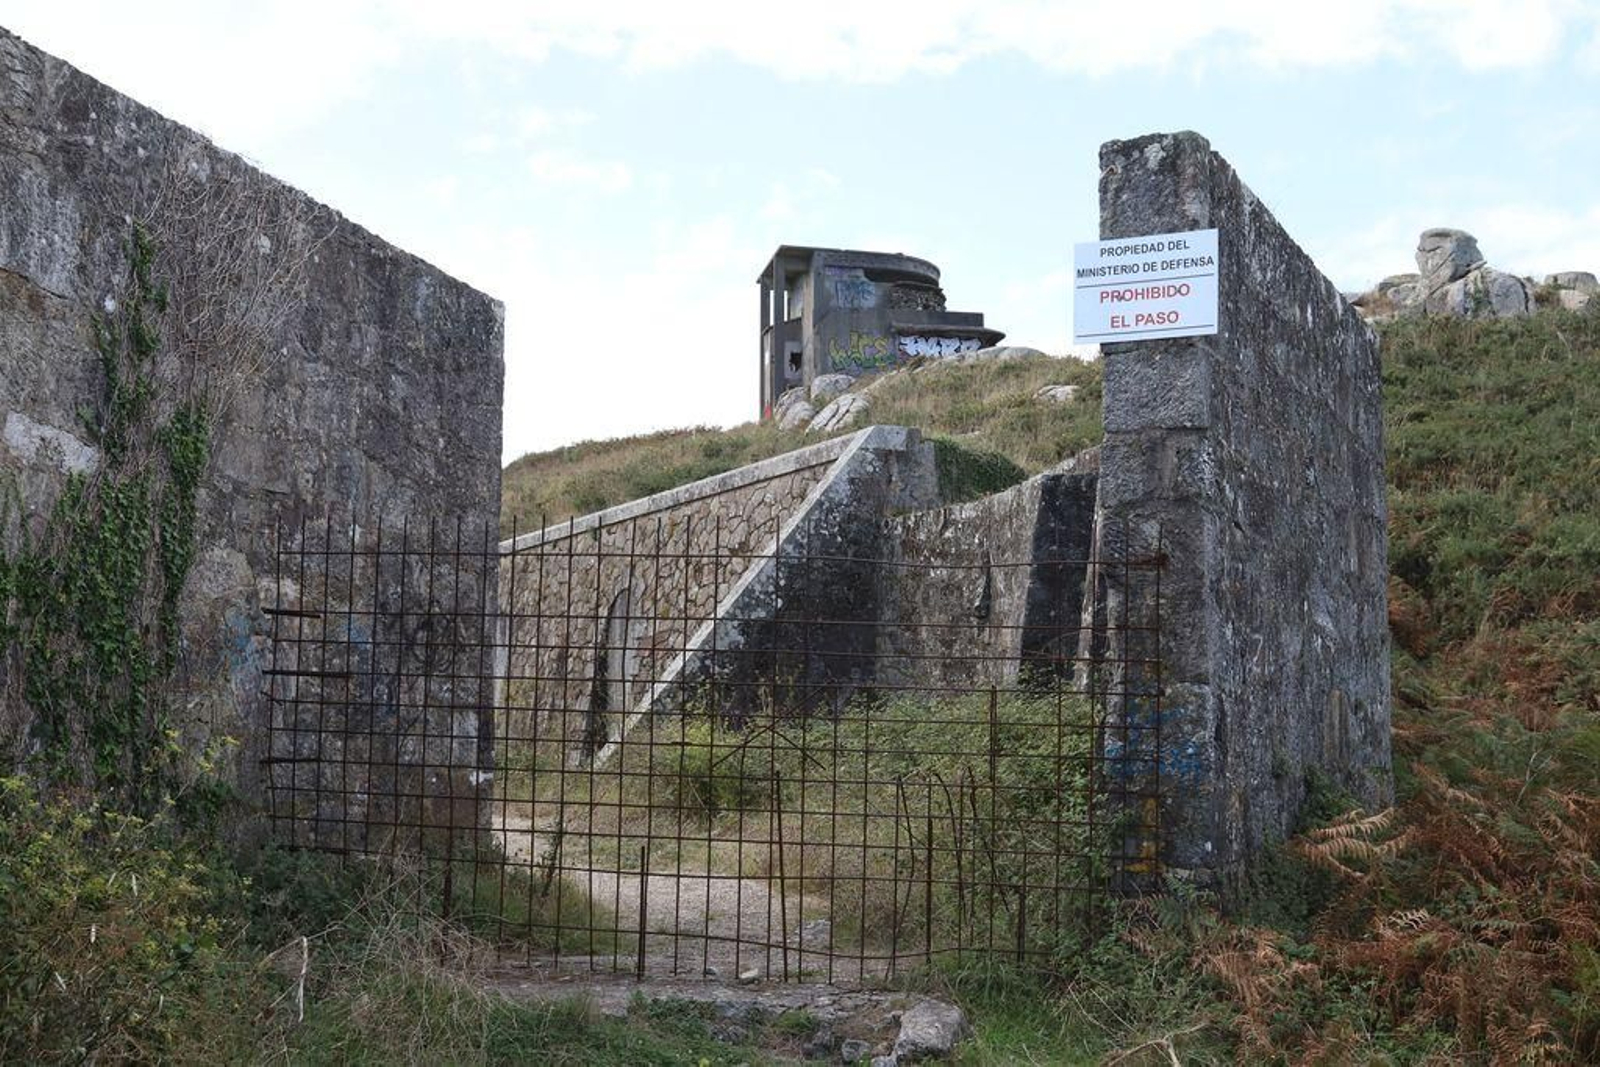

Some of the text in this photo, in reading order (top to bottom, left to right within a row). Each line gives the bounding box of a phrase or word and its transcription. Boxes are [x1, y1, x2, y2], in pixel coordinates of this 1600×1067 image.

[1100, 240, 1190, 257] PROPIEDAD DEL
[1077, 256, 1214, 278] MINISTERIO DE DEFENSA
[1100, 283, 1190, 303] PROHIBIDO
[1111, 311, 1178, 328] EL PASO
